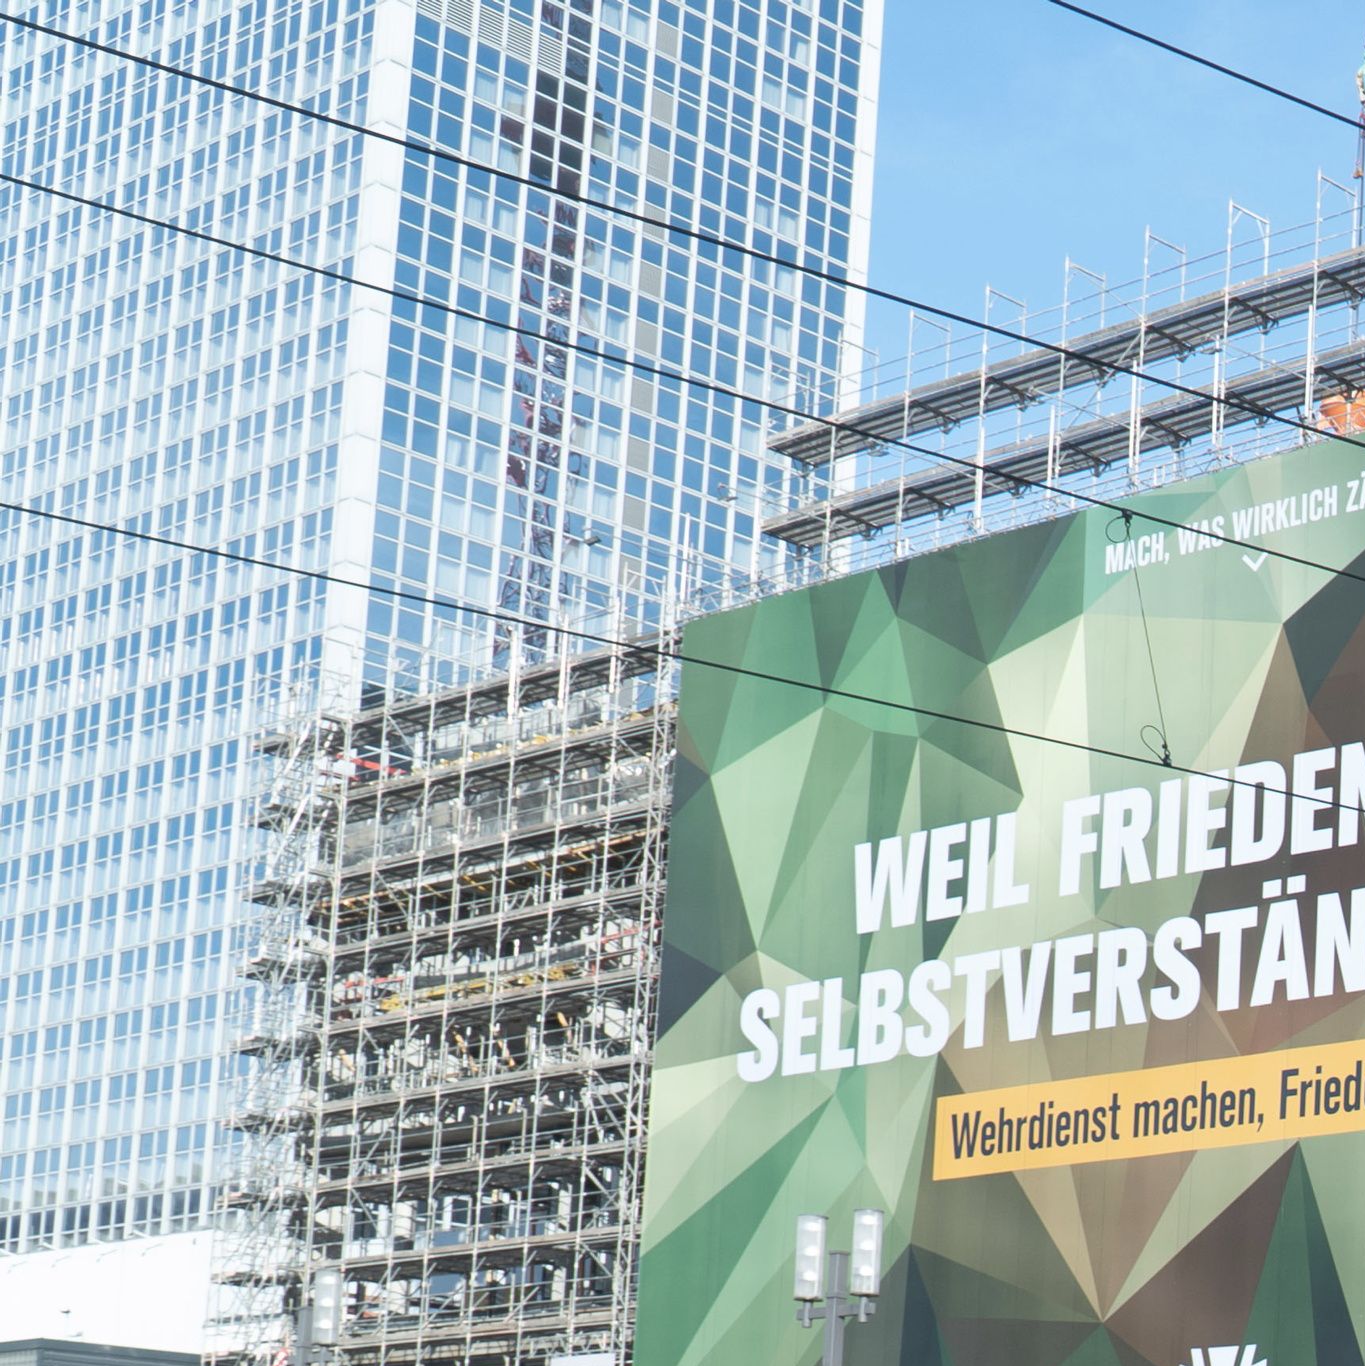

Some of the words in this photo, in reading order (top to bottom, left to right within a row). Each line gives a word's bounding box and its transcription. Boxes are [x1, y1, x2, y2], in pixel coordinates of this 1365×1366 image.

[1105, 532, 1170, 575] MACH,
[1178, 516, 1225, 555] WAS
[1232, 485, 1338, 542] WIRKLICH
[854, 812, 1029, 934] WEIL
[951, 1095, 1121, 1160] Wehrdienst
[1132, 1081, 1265, 1138] machen,
